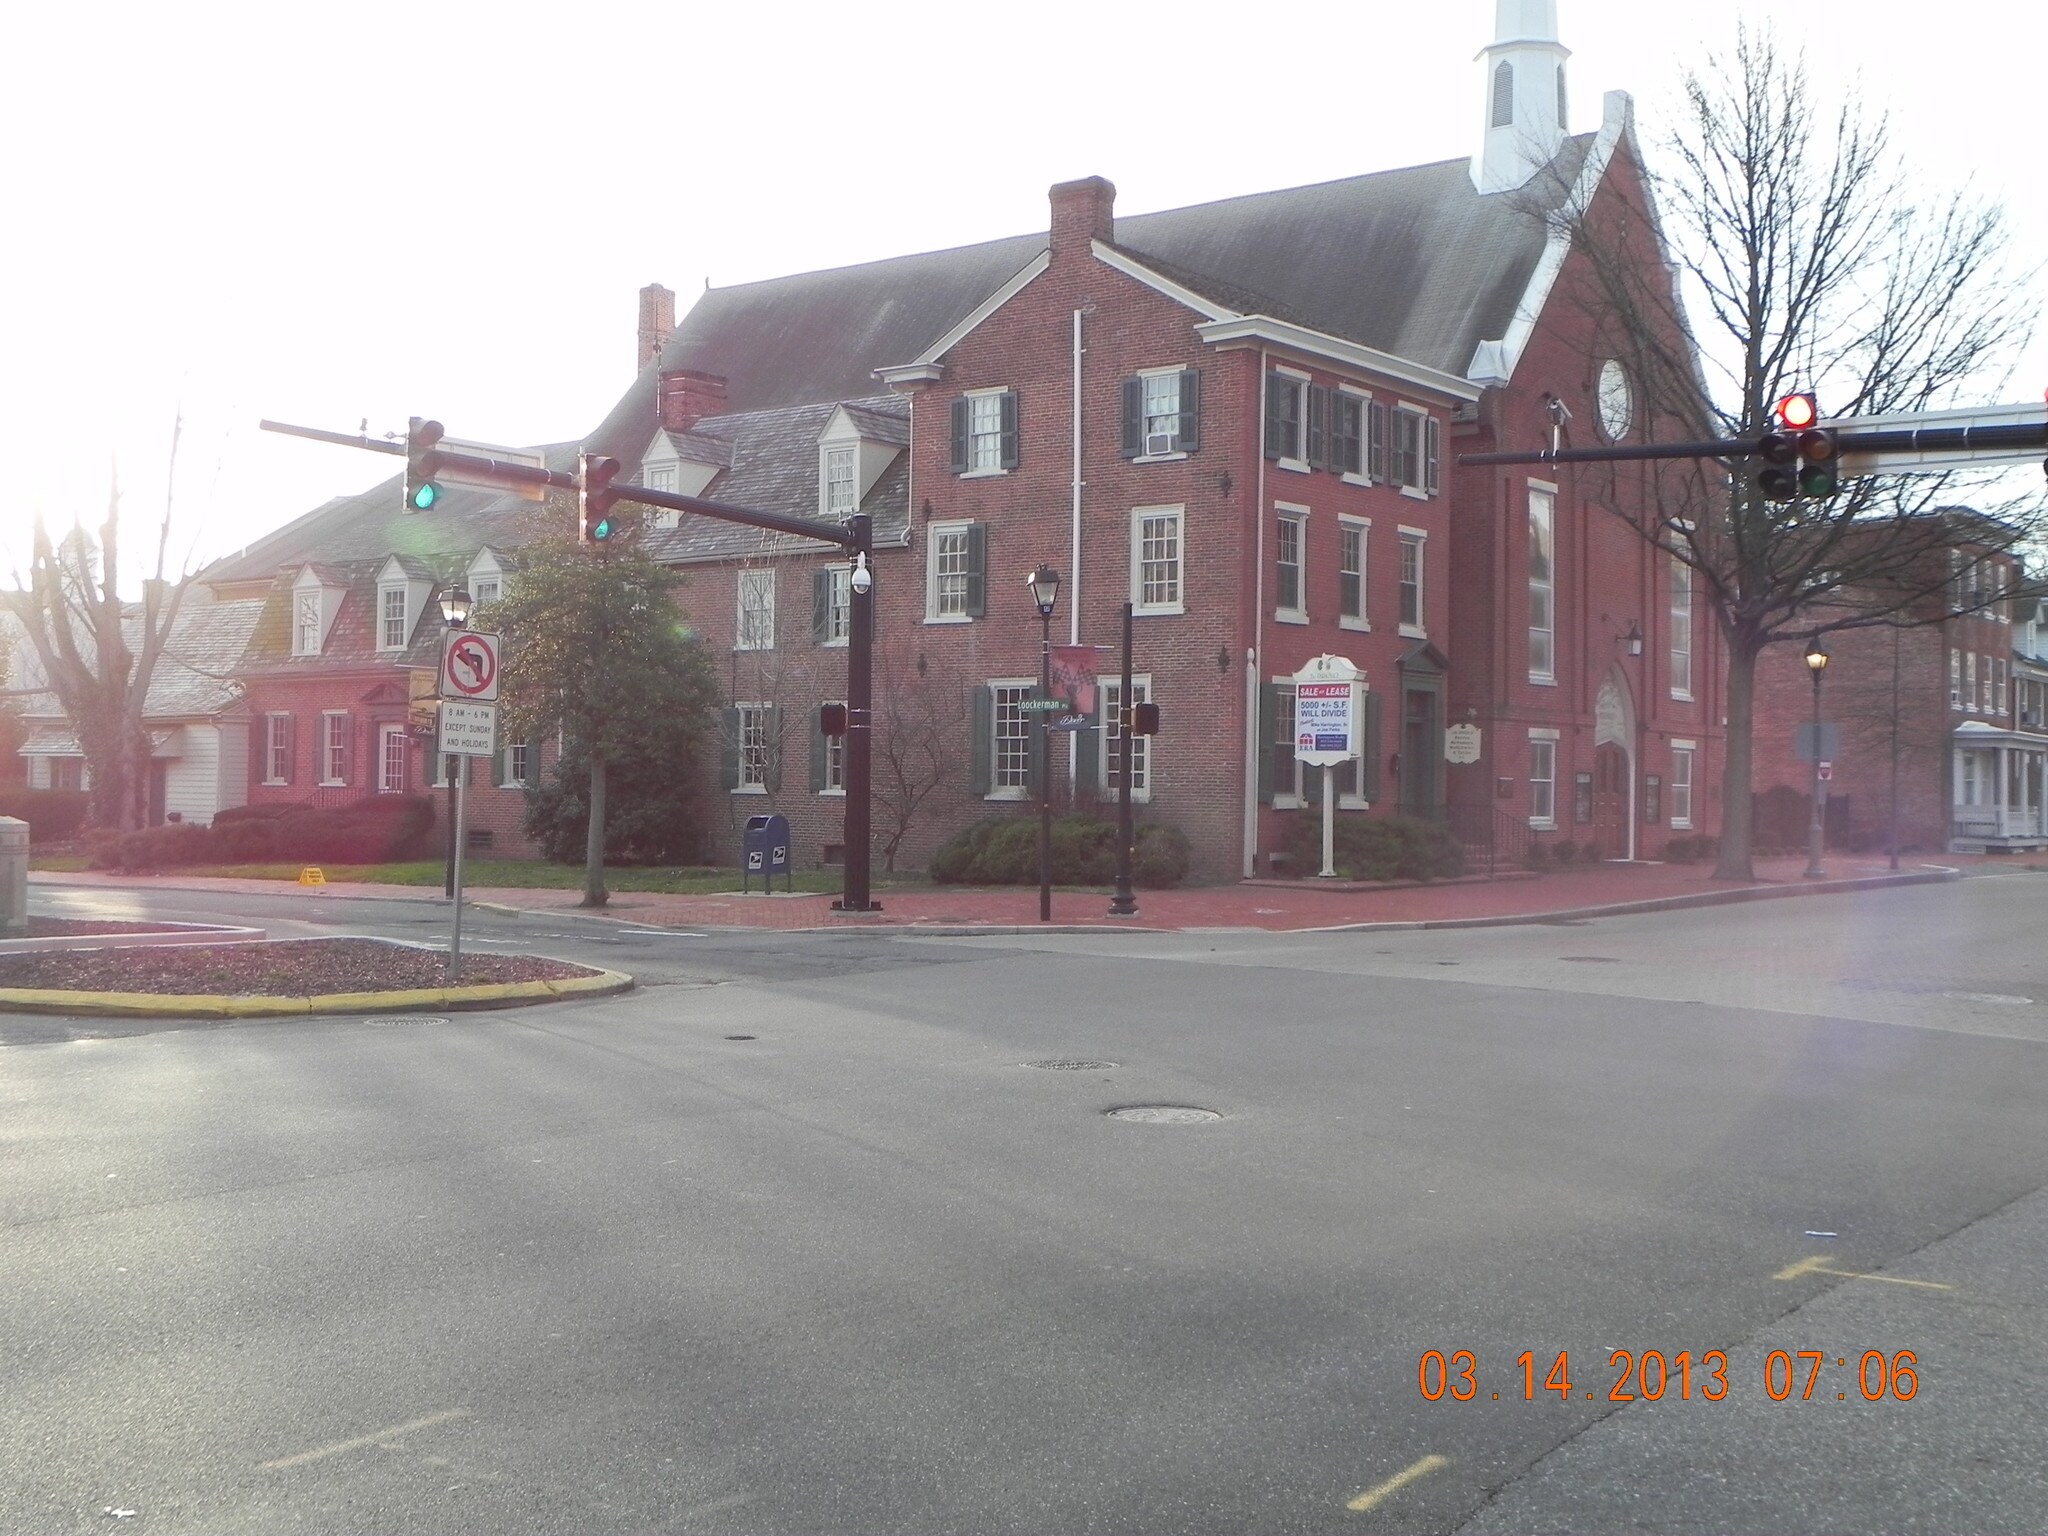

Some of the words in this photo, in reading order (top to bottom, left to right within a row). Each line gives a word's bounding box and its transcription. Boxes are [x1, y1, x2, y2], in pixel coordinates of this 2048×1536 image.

[1300, 687, 1319, 696] SALE
[1325, 687, 1350, 696] LEASE
[1017, 700, 1060, 710] Loockerman
[1301, 701, 1320, 710] 5000
[1321, 701, 1331, 709] +/-
[1333, 701, 1348, 709] S.F.
[448, 707, 454, 717] 8
[456, 709, 465, 717] AM
[474, 710, 479, 719] 6
[481, 710, 490, 719] PM
[1301, 709, 1319, 718] WILL
[1321, 709, 1348, 718] DIVIDE
[445, 722, 467, 732] EXCEPT
[469, 724, 491, 734] SUNDAY
[446, 738, 459, 747] AND
[461, 739, 489, 749] HOLIDAYS
